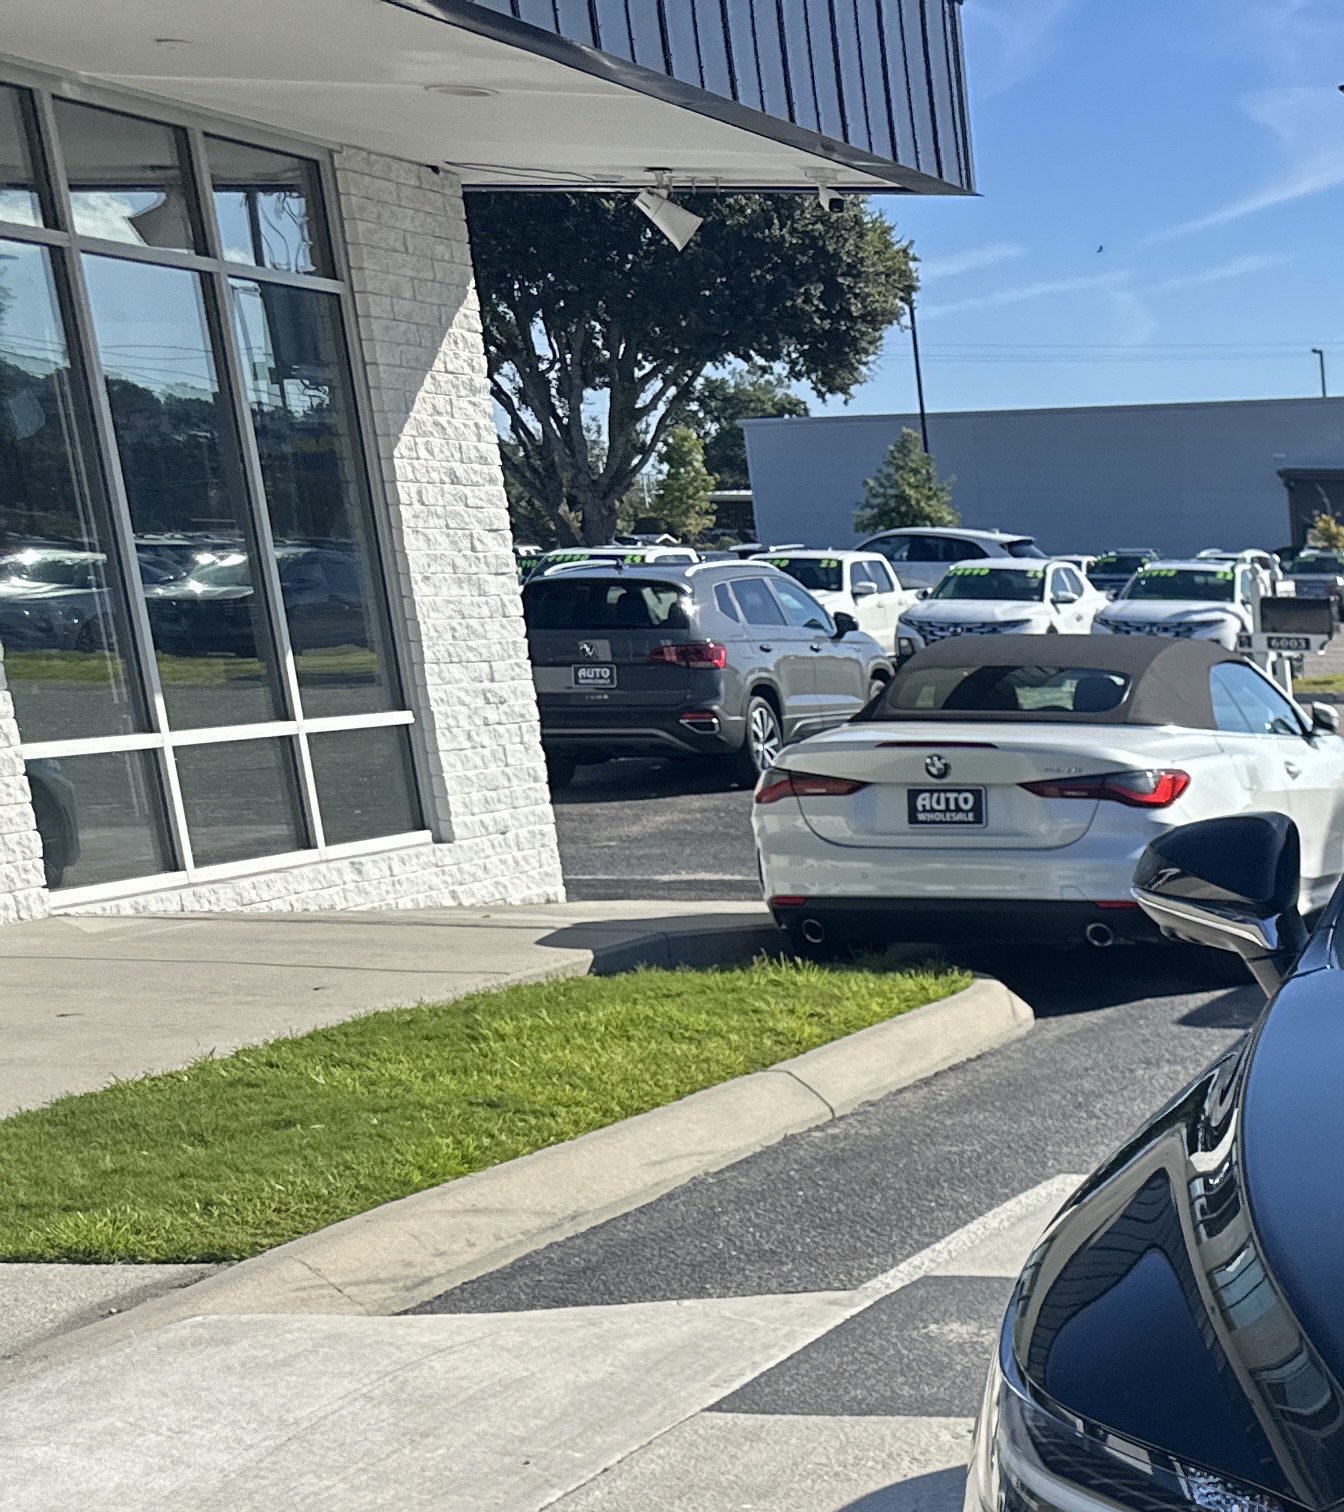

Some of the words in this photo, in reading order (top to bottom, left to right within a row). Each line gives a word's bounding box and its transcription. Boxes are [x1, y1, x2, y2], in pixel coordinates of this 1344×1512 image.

[578, 668, 611, 679] AUTO
[916, 792, 975, 811] AUTO
[917, 811, 975, 822] WHOLESALE
